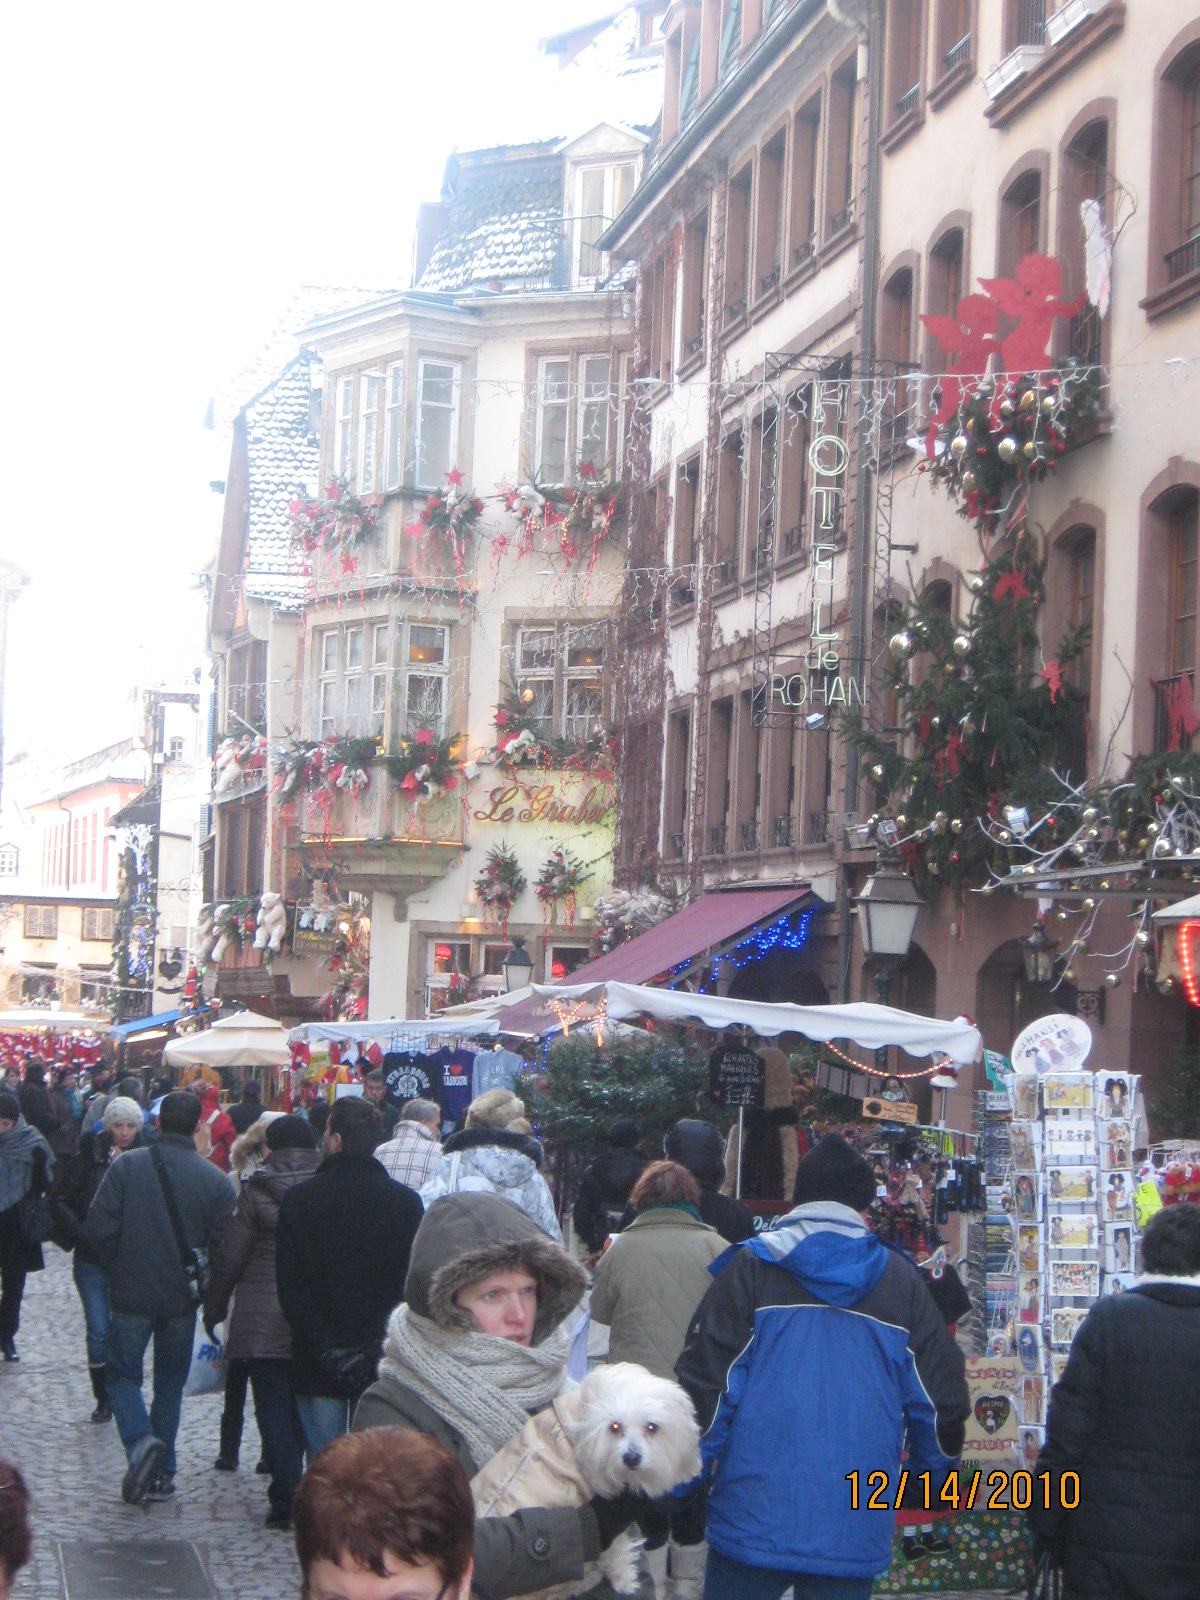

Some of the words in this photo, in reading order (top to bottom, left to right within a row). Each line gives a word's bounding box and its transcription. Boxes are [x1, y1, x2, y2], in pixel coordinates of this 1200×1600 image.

[809, 381, 851, 641] HOTEL
[804, 644, 839, 671] de
[770, 673, 866, 707] ROHAN
[473, 786, 519, 823] Le
[518, 785, 616, 826] Gruber
[752, 1214, 780, 1231] Dél
